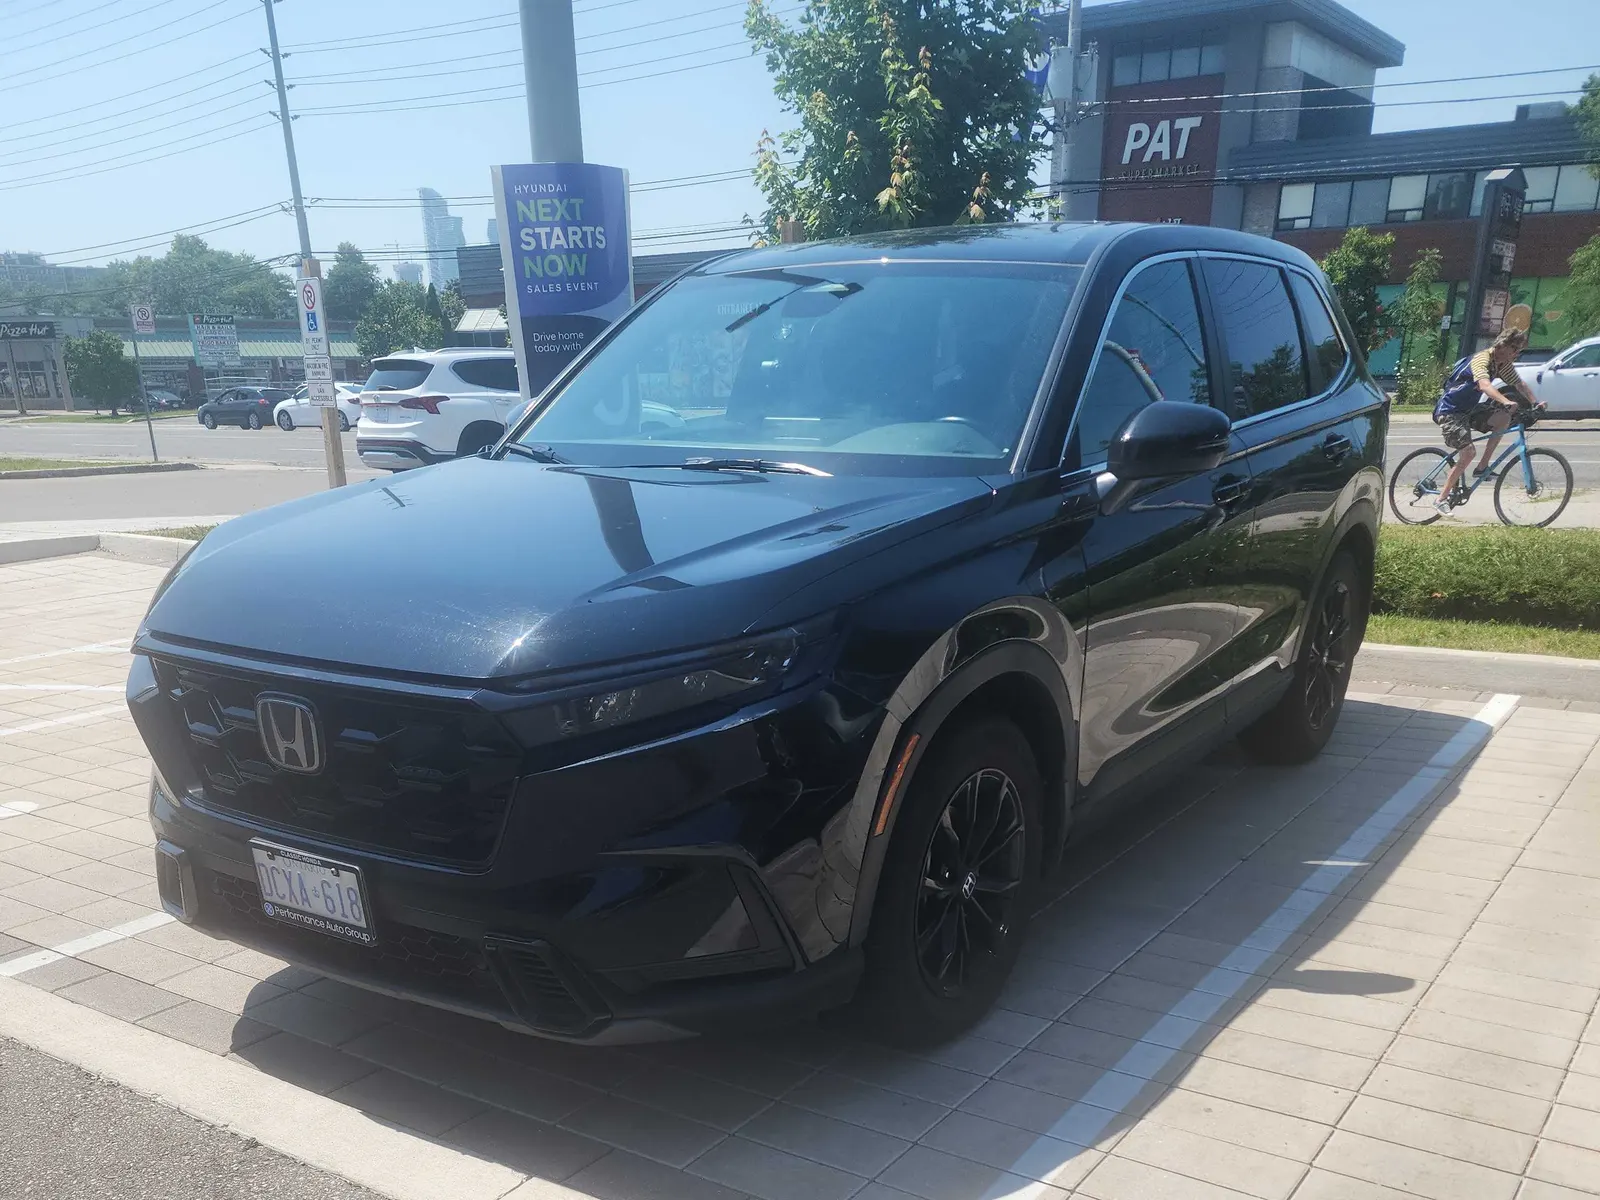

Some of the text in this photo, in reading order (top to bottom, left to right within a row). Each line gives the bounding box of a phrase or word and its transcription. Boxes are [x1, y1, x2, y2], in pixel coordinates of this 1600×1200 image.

[1121, 116, 1203, 165] PAT
[1121, 164, 1199, 181] SUPERMARKET
[514, 183, 567, 194] HYUNDAI
[516, 199, 584, 223] NEXT
[520, 226, 607, 251] STARTS
[523, 253, 588, 279] NOW
[526, 282, 600, 294] SALES EVENT
[0, 323, 49, 338] Pizza Hut
[533, 332, 584, 342] Drive home
[534, 342, 582, 354] today with
[320, 879, 362, 922] 618
[274, 905, 371, 943] Performance Auto Group
